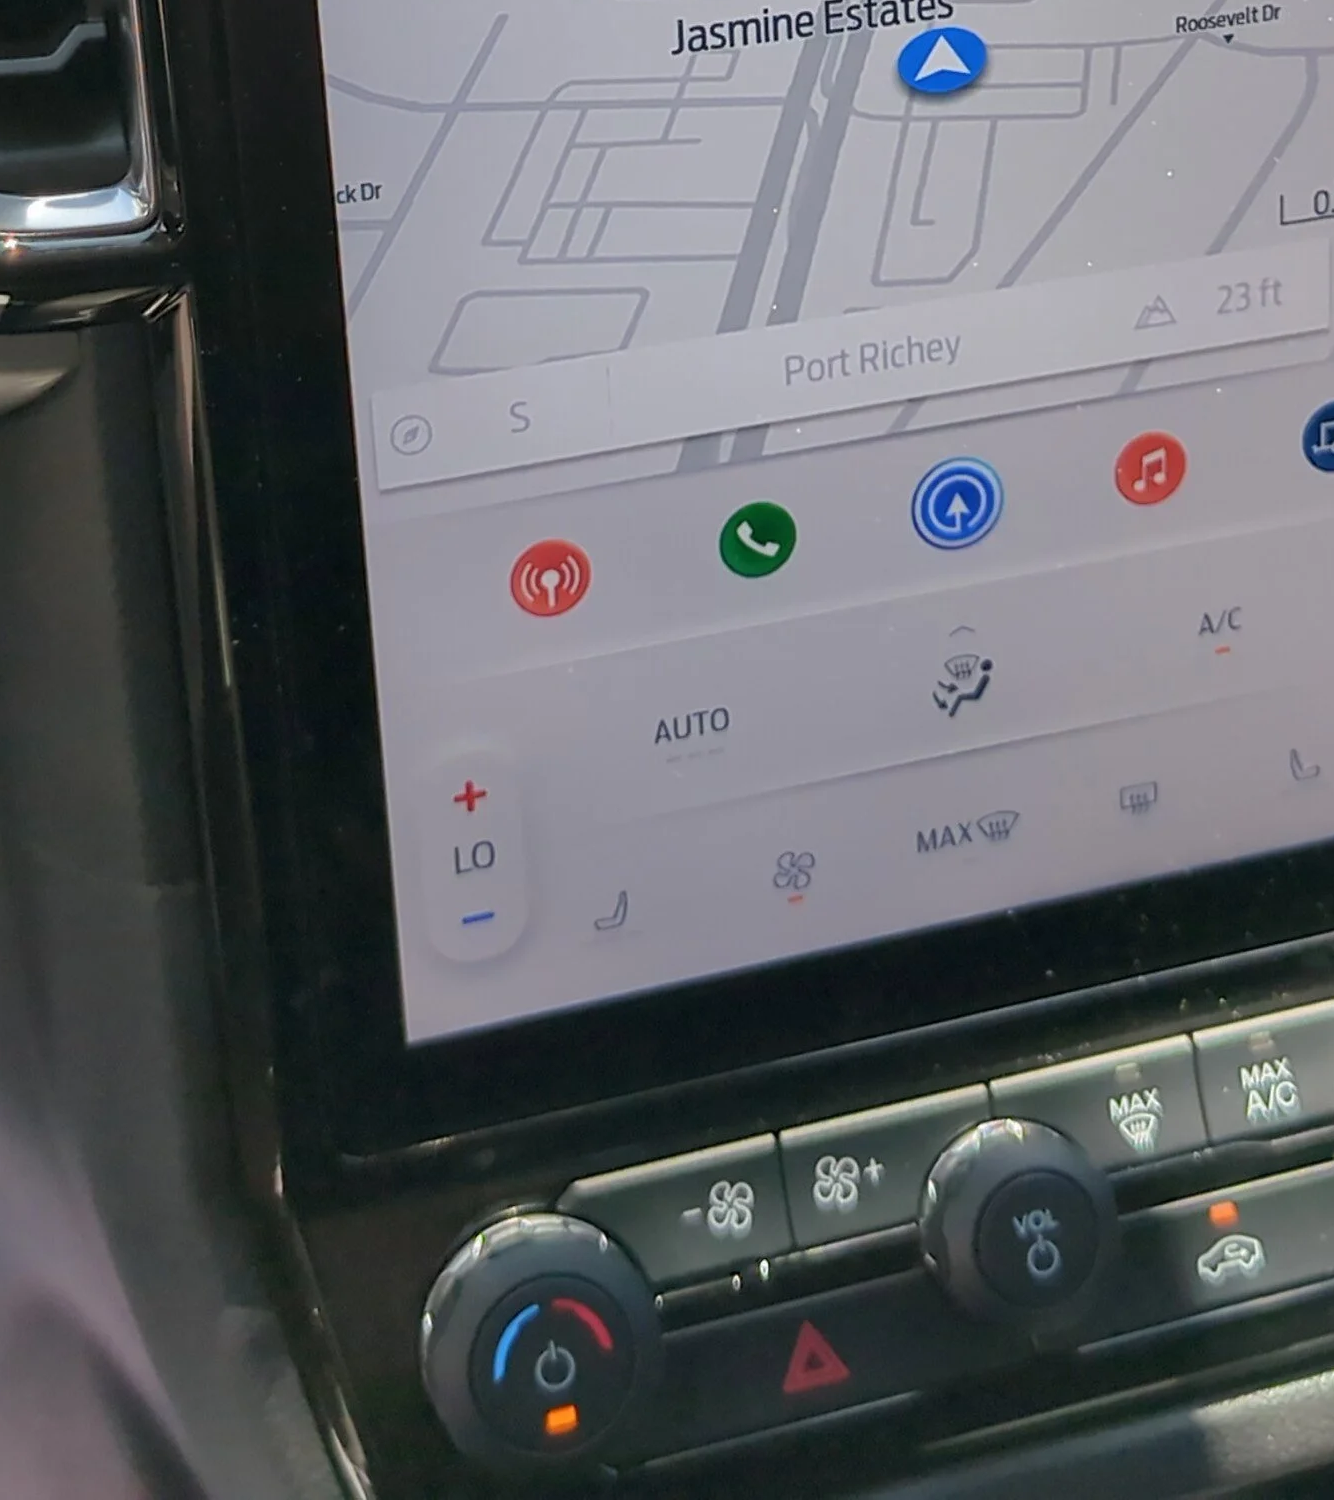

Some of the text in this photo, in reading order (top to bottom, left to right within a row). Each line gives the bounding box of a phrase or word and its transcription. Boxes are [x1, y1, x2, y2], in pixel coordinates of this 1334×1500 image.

[671, 0, 954, 55] Jasmine Estates
[1176, 5, 1281, 34] Roosevelt Dr
[361, 181, 382, 201] Dr
[1216, 278, 1282, 314] 23 ft
[785, 335, 961, 384] Port Richey
[510, 402, 531, 434] S
[1199, 607, 1242, 635] A/C
[655, 708, 730, 745] AUTO
[917, 822, 974, 852] MAX
[455, 841, 496, 874] LO
[1240, 1057, 1292, 1088] MAX
[1110, 1087, 1163, 1116] MAX
[1247, 1079, 1301, 1119] A/C
[1013, 1210, 1058, 1238] VOL
